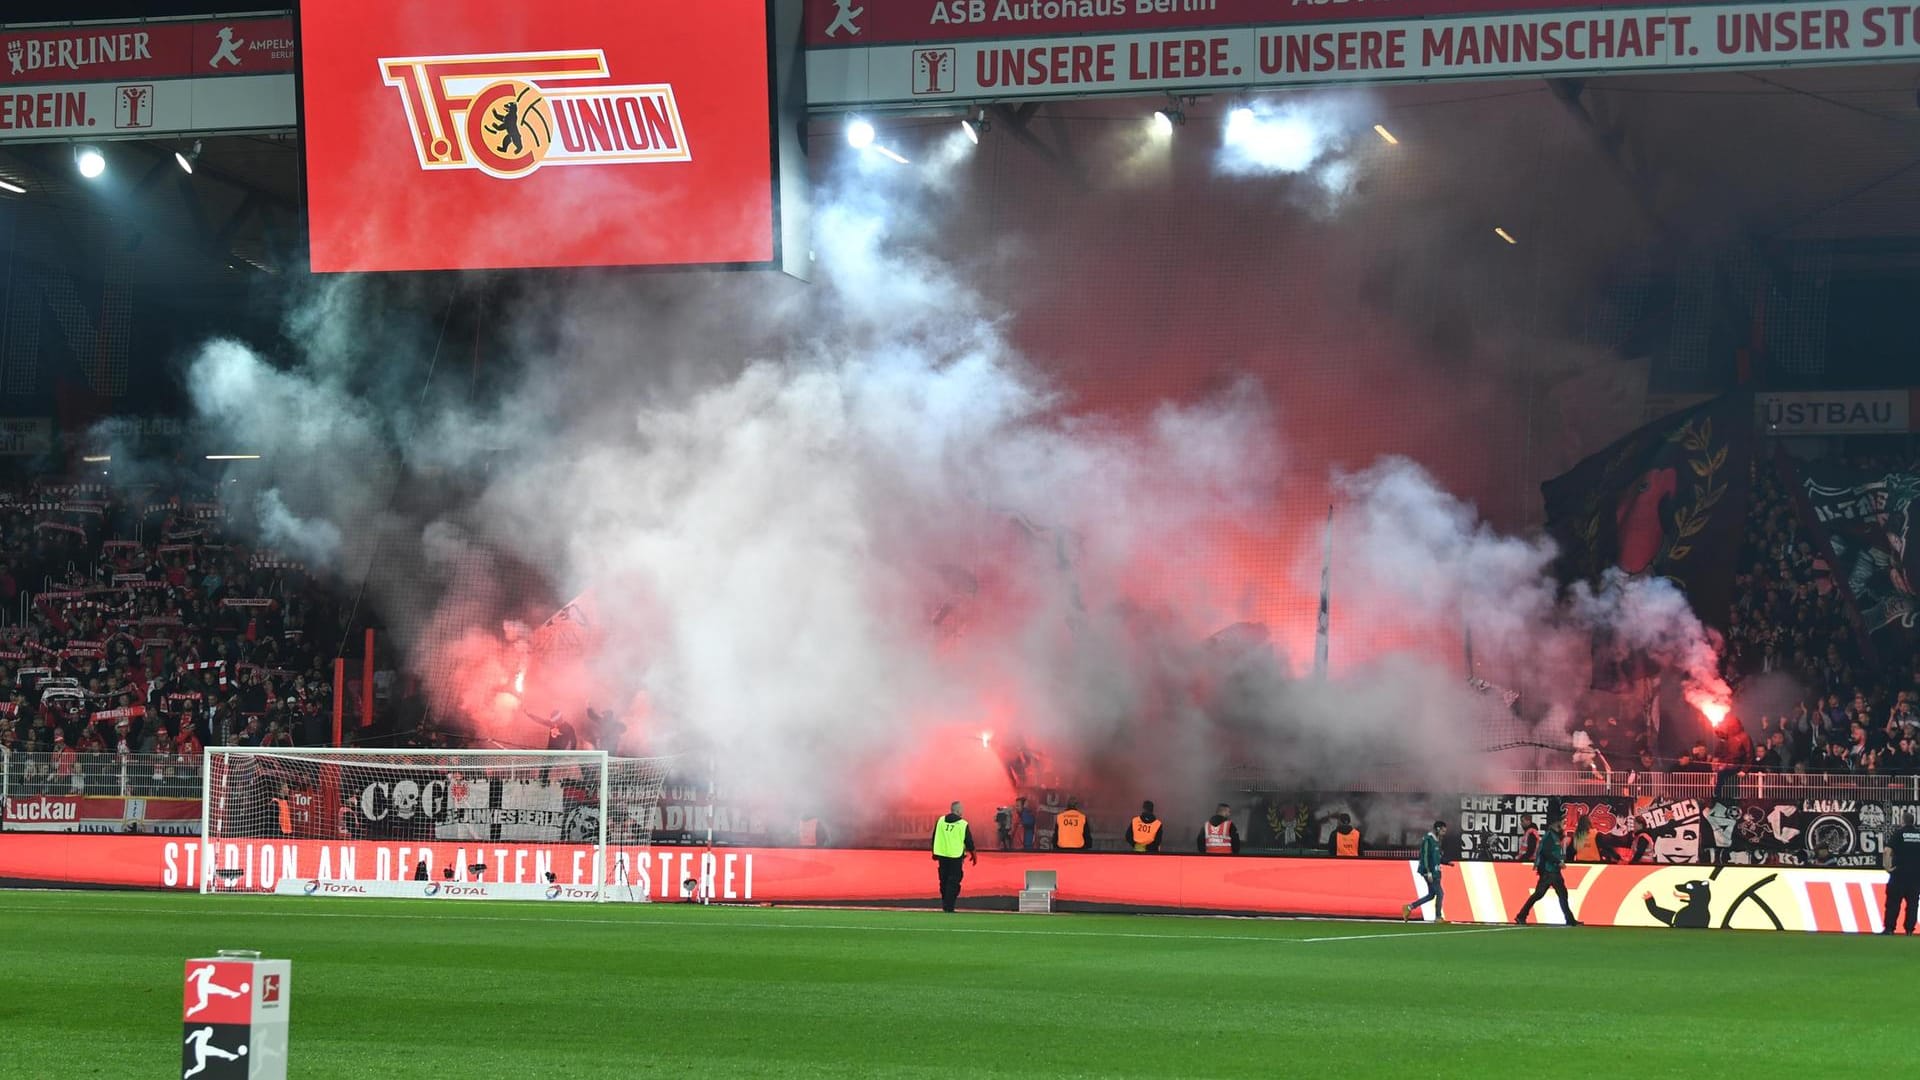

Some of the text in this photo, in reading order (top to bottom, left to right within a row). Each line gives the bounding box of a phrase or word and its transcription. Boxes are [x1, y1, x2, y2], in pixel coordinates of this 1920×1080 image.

[930, 0, 987, 25] ASB
[992, 0, 1126, 22] Autohaus
[26, 32, 152, 70] BERLINER
[976, 44, 1116, 88] UNSERE
[1129, 38, 1242, 80] LIEBE.
[1259, 30, 1406, 75] UNSERE
[1422, 16, 1698, 67] MANNSCHAFT.
[1716, 9, 1850, 54] UNSER
[551, 95, 678, 153] UNION
[6, 797, 76, 819] Luckau
[294, 793, 312, 805] Tor
[1461, 796, 1549, 813] EHRE DER
[945, 824, 955, 832] 17
[1063, 818, 1079, 827] 043
[1137, 823, 1152, 833] 201
[1860, 831, 1884, 853] 61
[164, 842, 297, 889] STADION
[318, 845, 355, 881] AN
[323, 883, 366, 893] TOTAL
[444, 885, 489, 896] TOTAL
